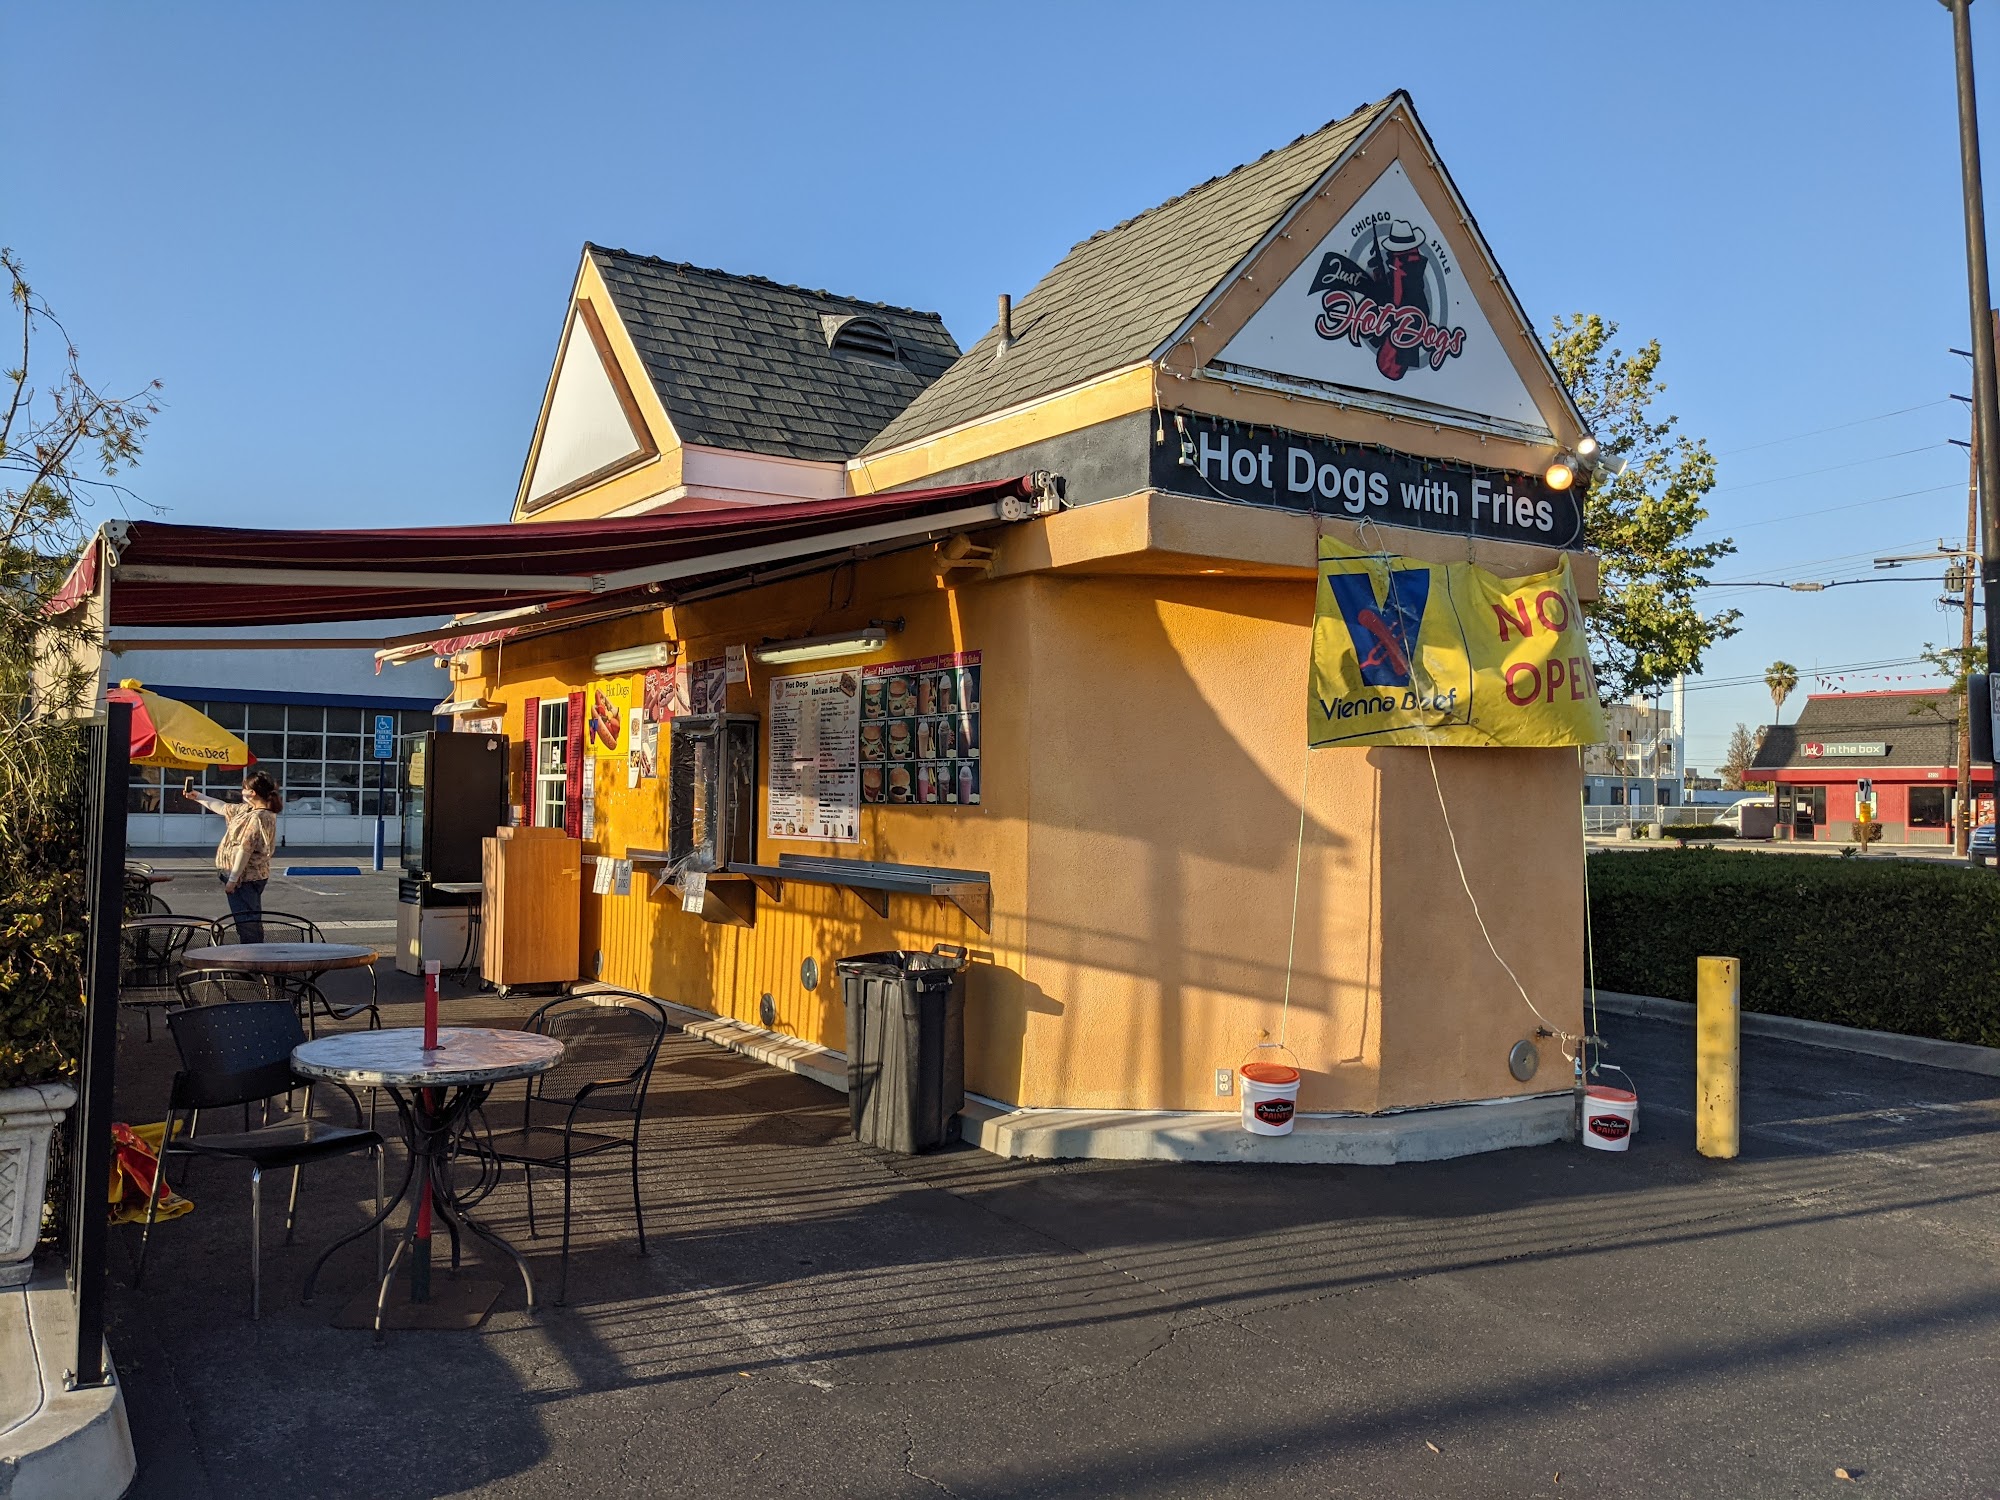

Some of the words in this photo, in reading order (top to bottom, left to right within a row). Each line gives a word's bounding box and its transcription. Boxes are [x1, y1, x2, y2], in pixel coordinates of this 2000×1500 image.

[1351, 211, 1391, 237] CHICAGO
[1430, 240, 1451, 275] STYLE
[1322, 258, 1367, 286] Just
[1316, 290, 1391, 346] Hot
[1391, 305, 1466, 371] Dogs
[1200, 431, 1273, 488] Hot
[1287, 446, 1389, 513] Dogs
[1400, 479, 1459, 516] with
[1471, 480, 1553, 531] Fries
[878, 664, 916, 675] Hamburger
[606, 684, 616, 697] Hot
[617, 683, 629, 698] Dogs
[785, 682, 795, 690] Hot
[795, 681, 809, 689] Dogs
[811, 687, 828, 696] Italian
[1320, 695, 1395, 721] Vienna
[1401, 688, 1457, 714] Beef
[172, 740, 204, 757] Vienna
[204, 748, 230, 762] Beef
[1826, 745, 1838, 754] in
[1839, 745, 1857, 753] the
[1859, 744, 1881, 753] box
[1596, 1126, 1625, 1134] PAINTS
